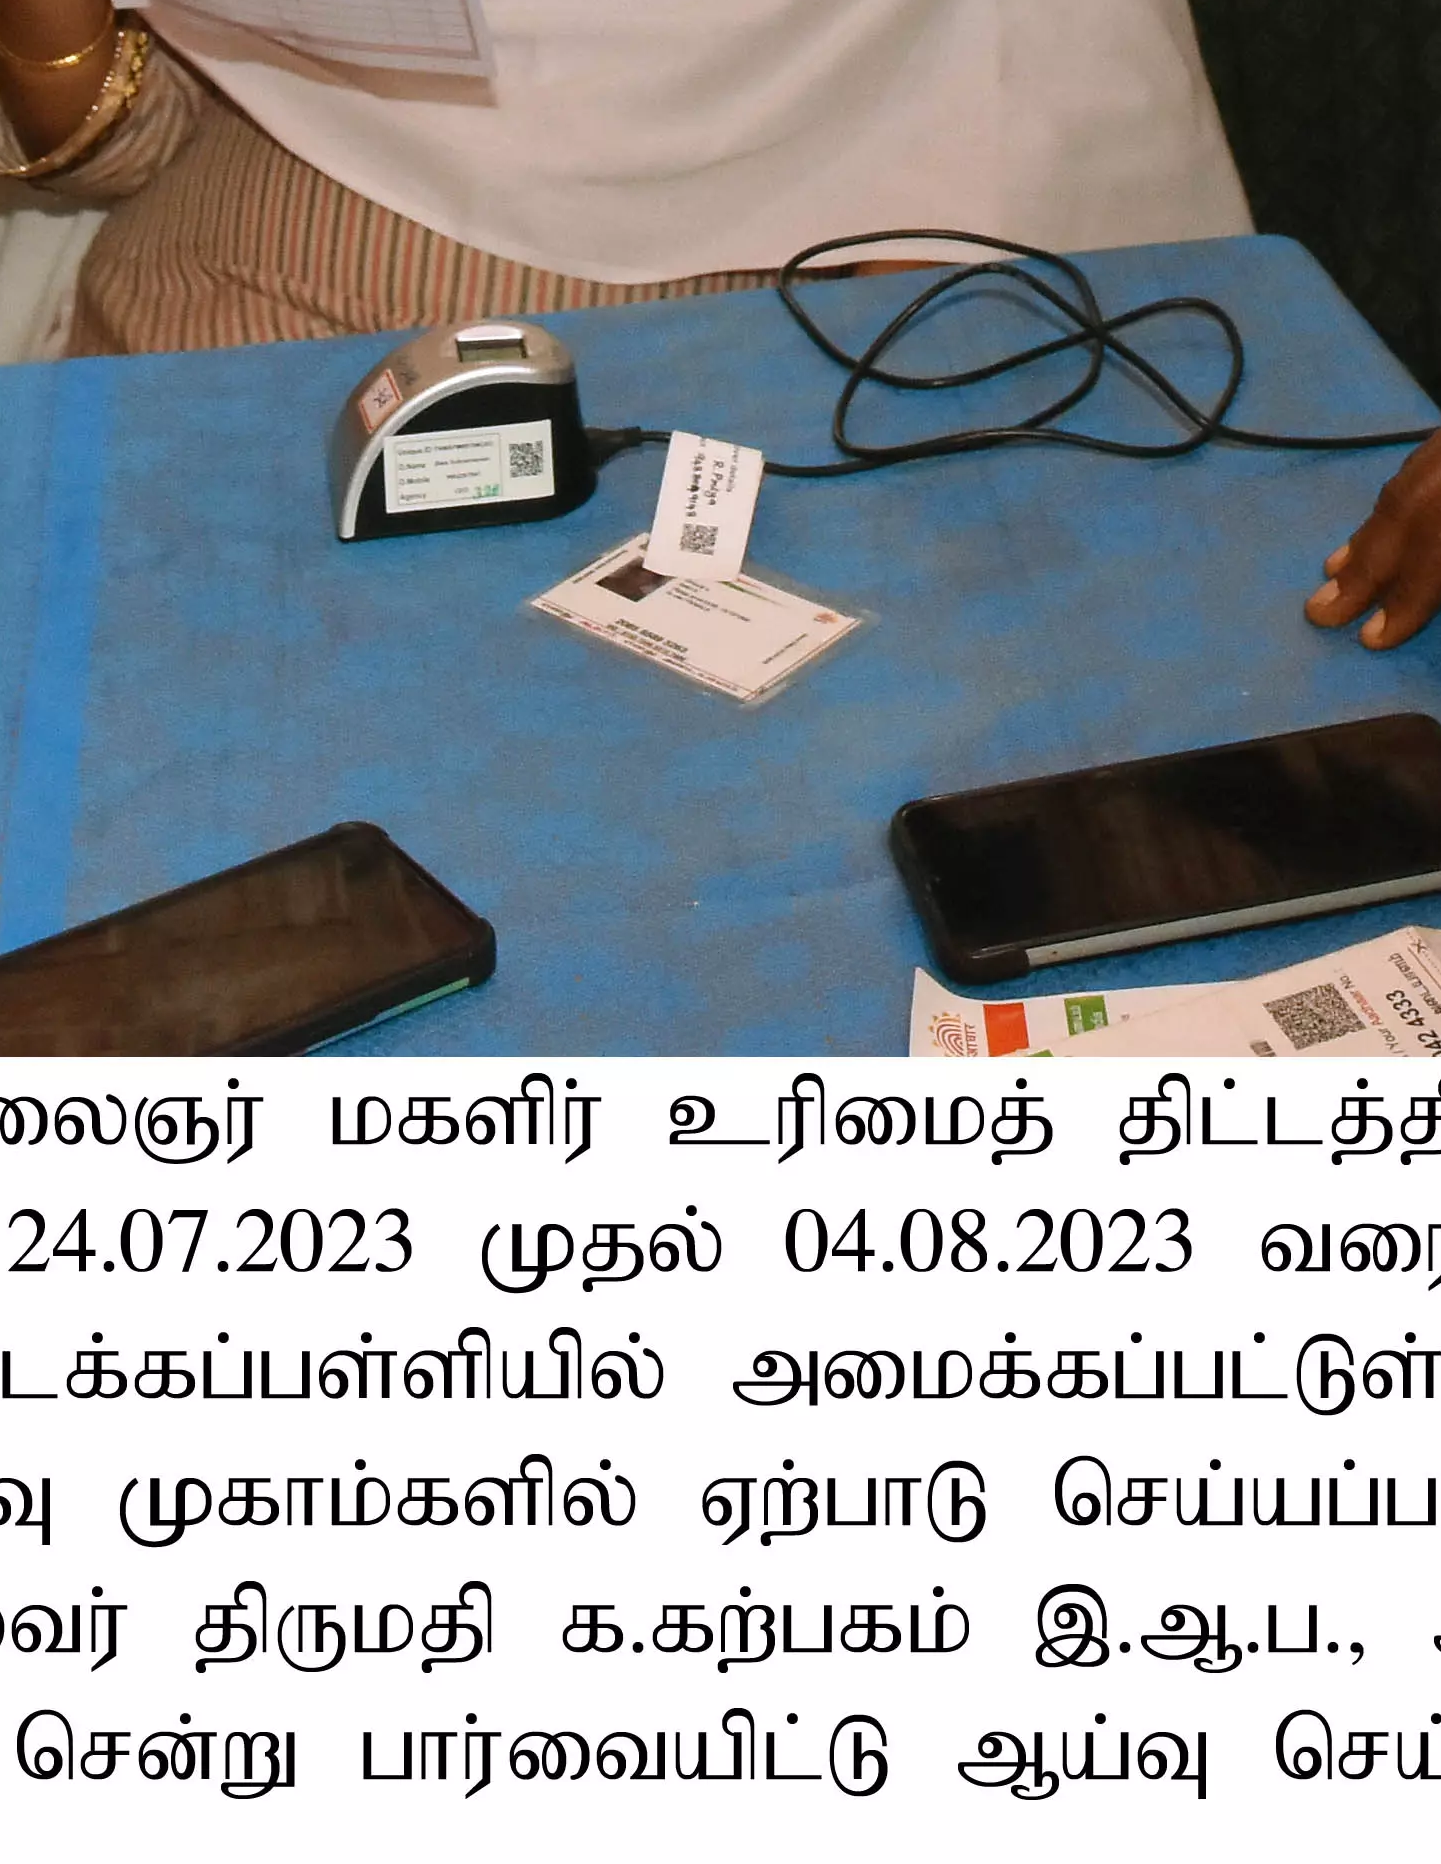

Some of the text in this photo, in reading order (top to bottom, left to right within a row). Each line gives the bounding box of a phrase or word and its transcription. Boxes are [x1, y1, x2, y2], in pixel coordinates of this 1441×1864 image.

[1349, 989, 1383, 1027] Aadhaar
[1385, 989, 1426, 1027] 4333
[1377, 1026, 1399, 1050] Your
